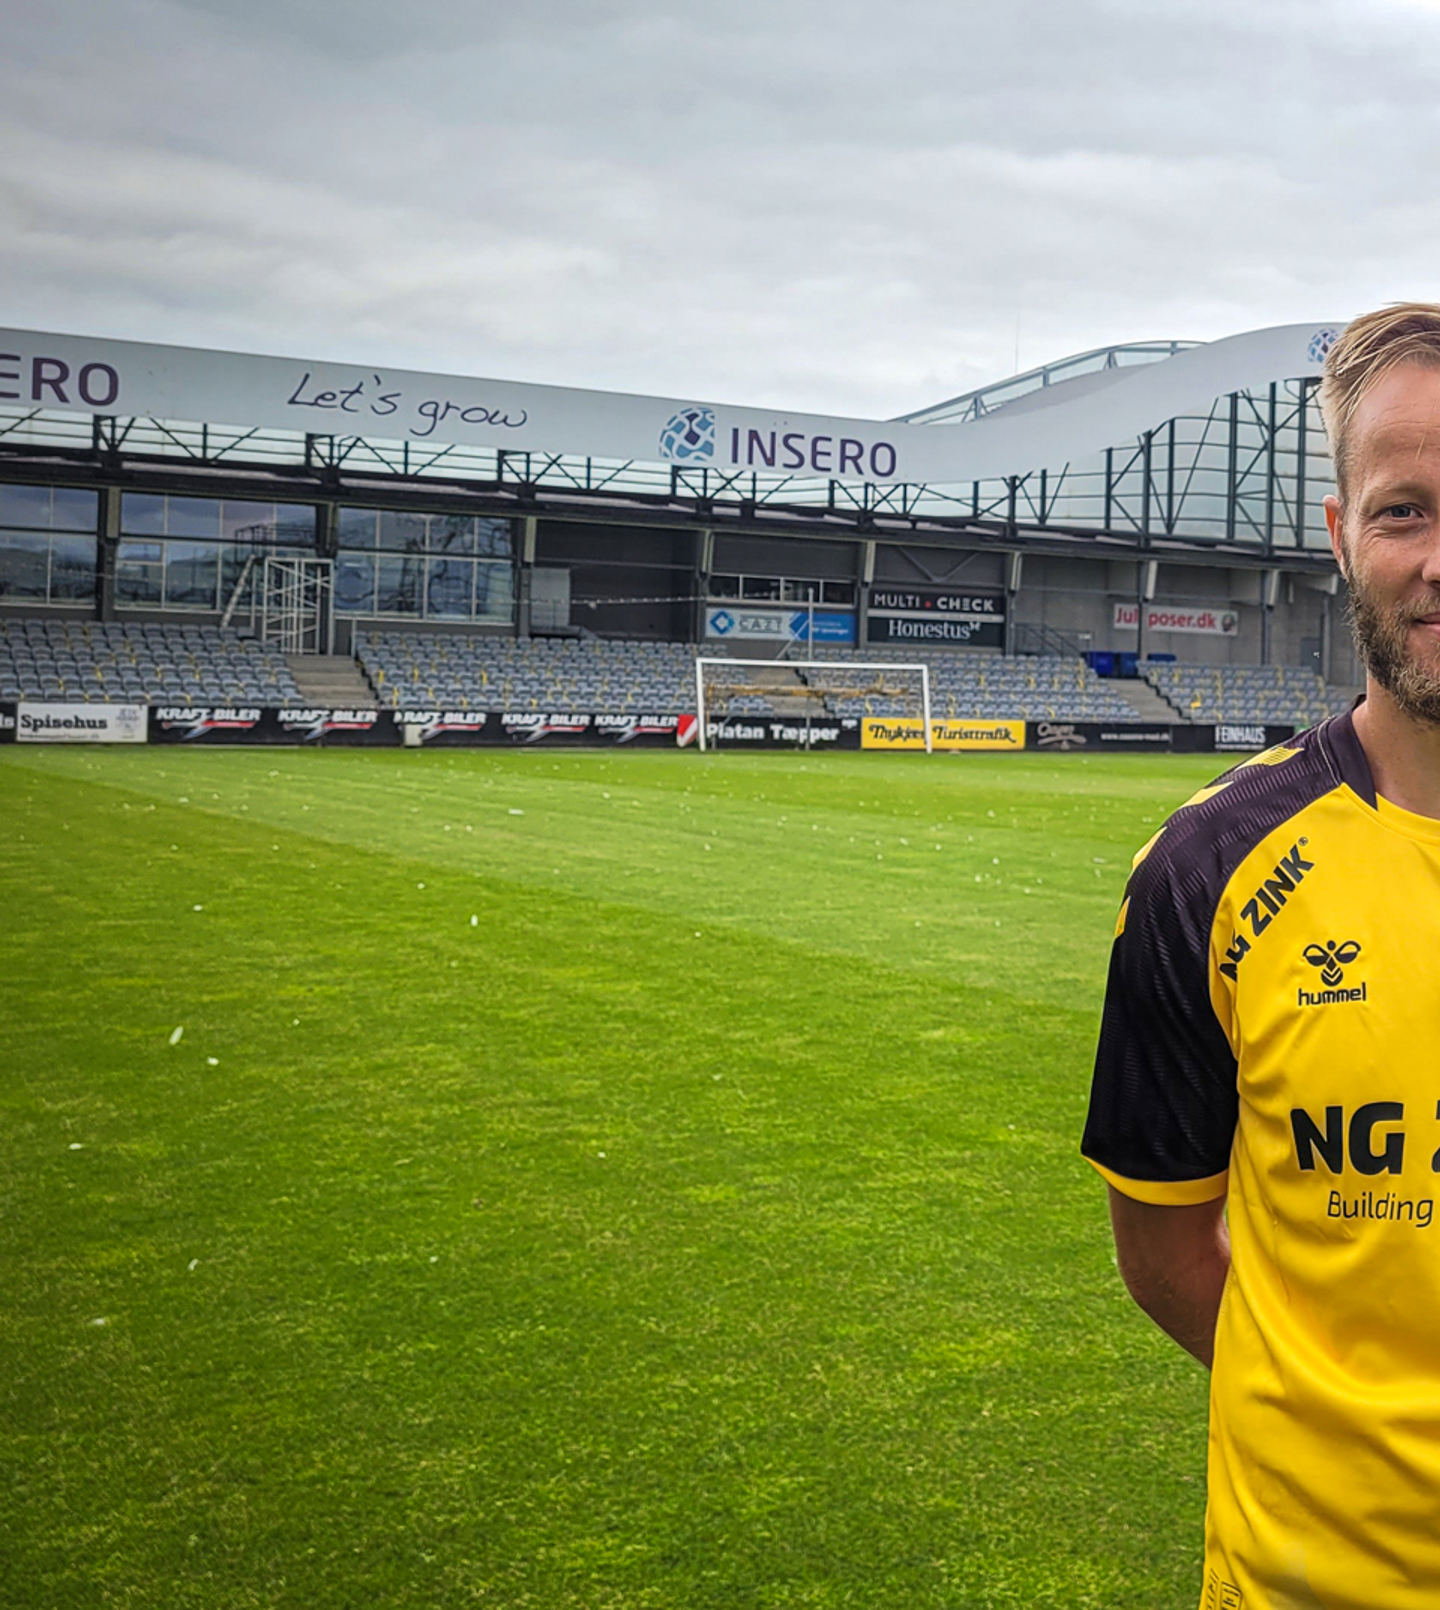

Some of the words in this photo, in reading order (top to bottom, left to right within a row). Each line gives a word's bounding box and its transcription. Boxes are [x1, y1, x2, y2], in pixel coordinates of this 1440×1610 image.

[287, 373, 401, 416] Let's
[409, 401, 528, 436] grow
[731, 427, 897, 478] INSERO
[874, 593, 920, 608] MULTI
[936, 596, 994, 612] CHECK
[888, 619, 972, 640] Honestus
[213, 709, 261, 721] BILER
[331, 710, 378, 722] BILER
[443, 711, 487, 723] BILER
[549, 714, 591, 726] BILER
[707, 723, 764, 739] Platan
[1298, 982, 1366, 1006] hummel
[1290, 1102, 1405, 1175] NG
[1327, 1190, 1432, 1228] Building
